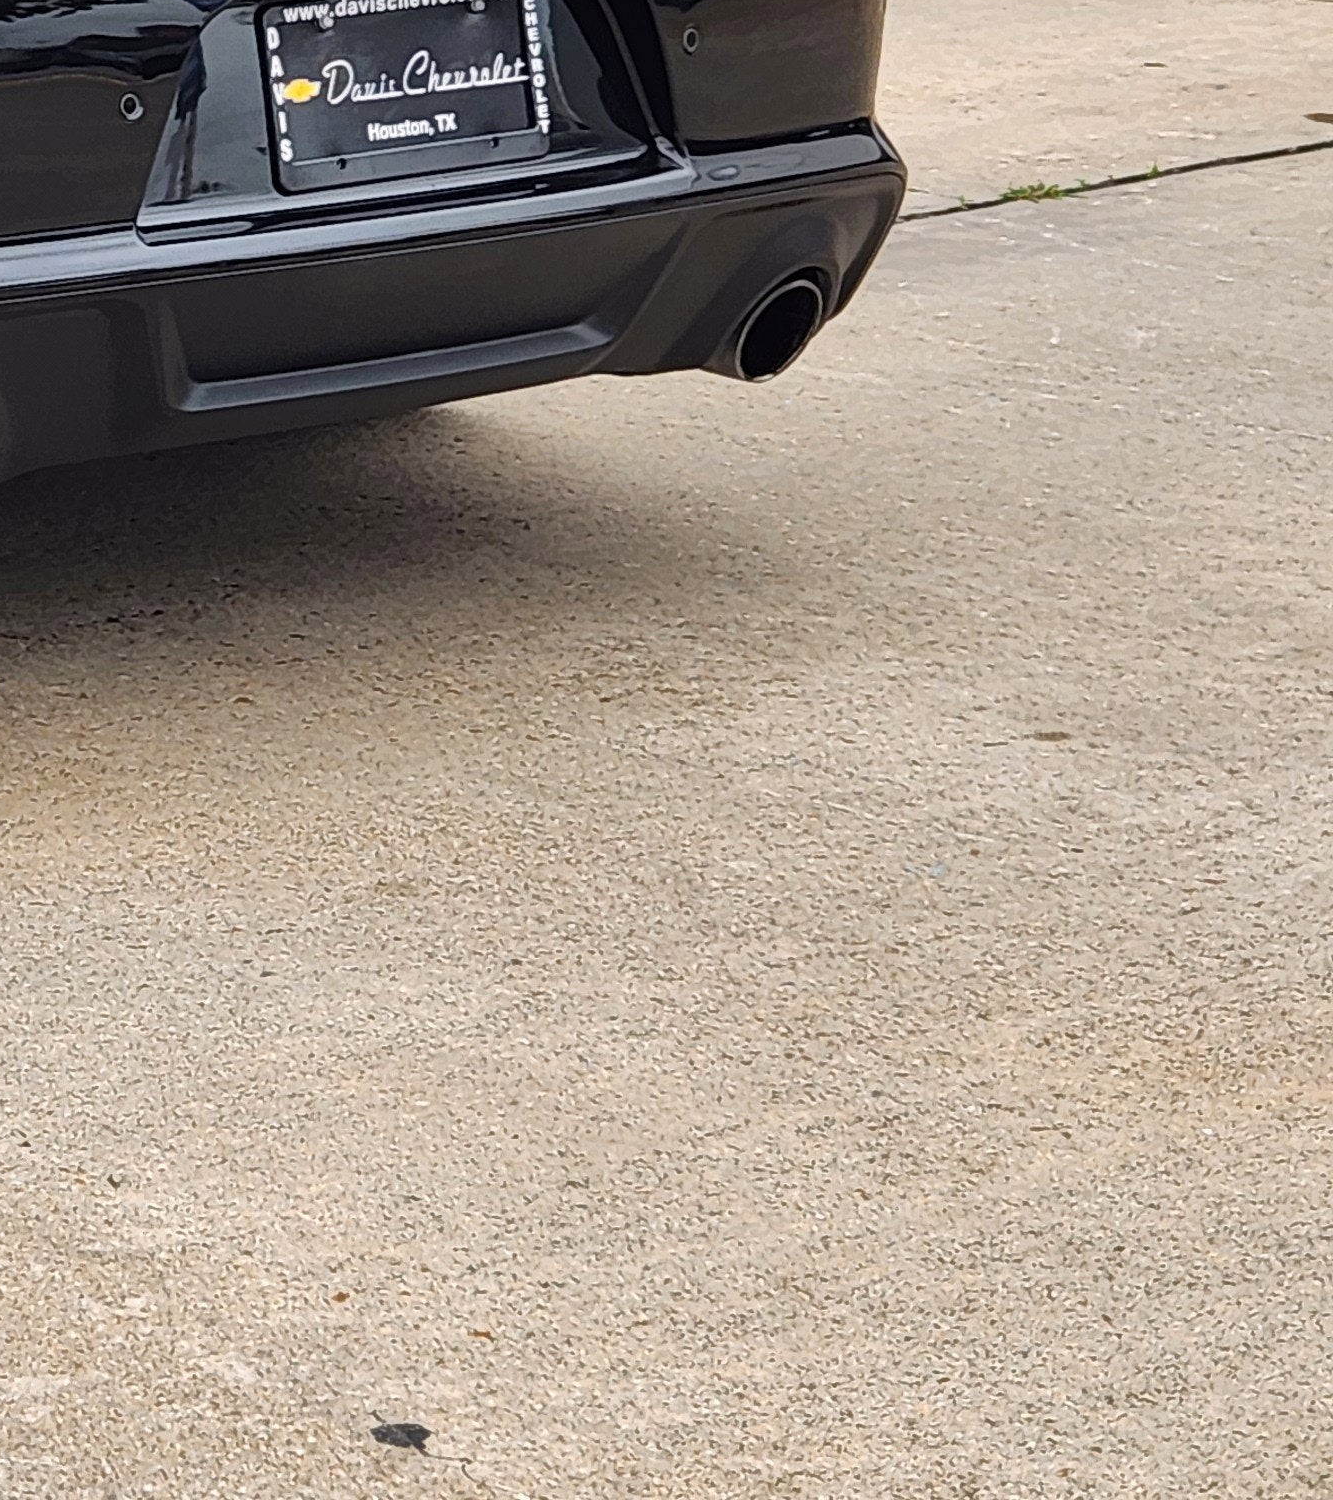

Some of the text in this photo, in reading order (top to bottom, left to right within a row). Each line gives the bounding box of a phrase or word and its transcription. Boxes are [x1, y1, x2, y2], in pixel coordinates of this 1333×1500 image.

[266, 25, 294, 163] DAVIS
[321, 49, 531, 105] Davis Chevrolet
[366, 112, 458, 142] Houston, TX
